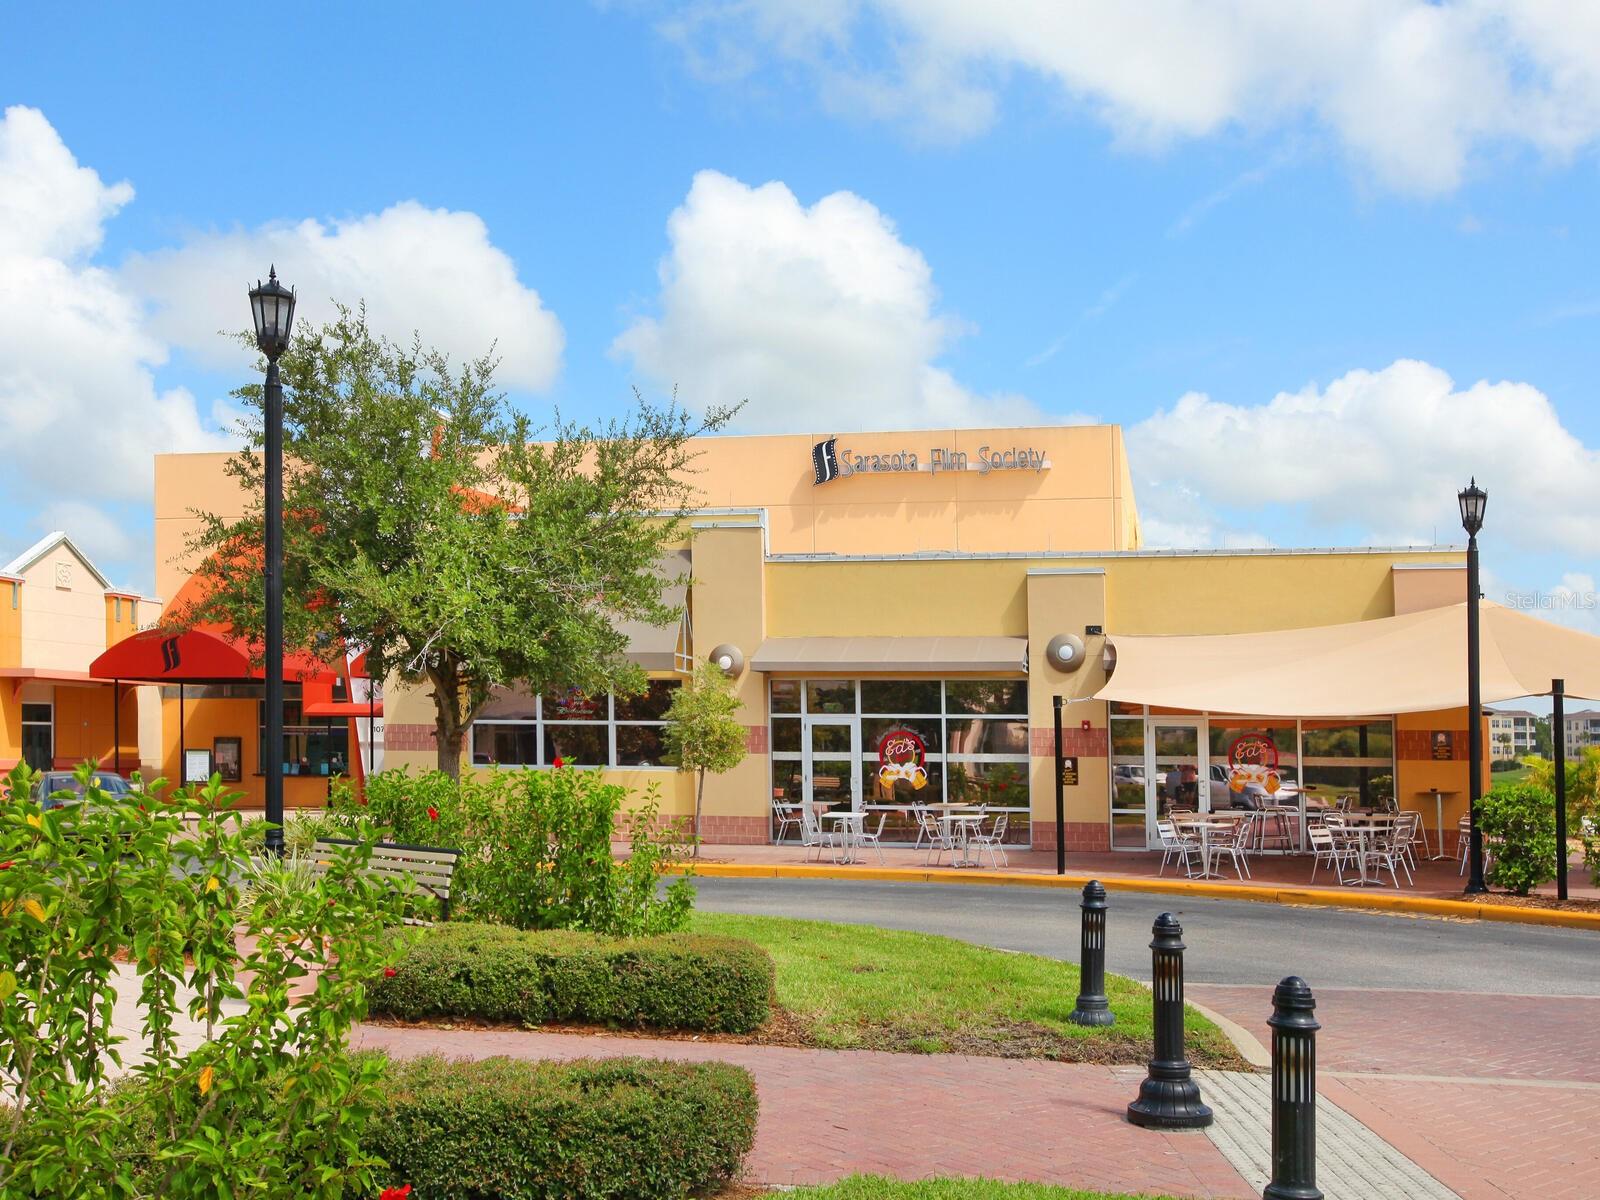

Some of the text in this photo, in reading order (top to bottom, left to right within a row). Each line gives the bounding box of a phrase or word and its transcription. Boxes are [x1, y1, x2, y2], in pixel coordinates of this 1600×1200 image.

[841, 446, 1046, 478] Sarasota Film Society
[885, 737, 916, 756] Ed's
